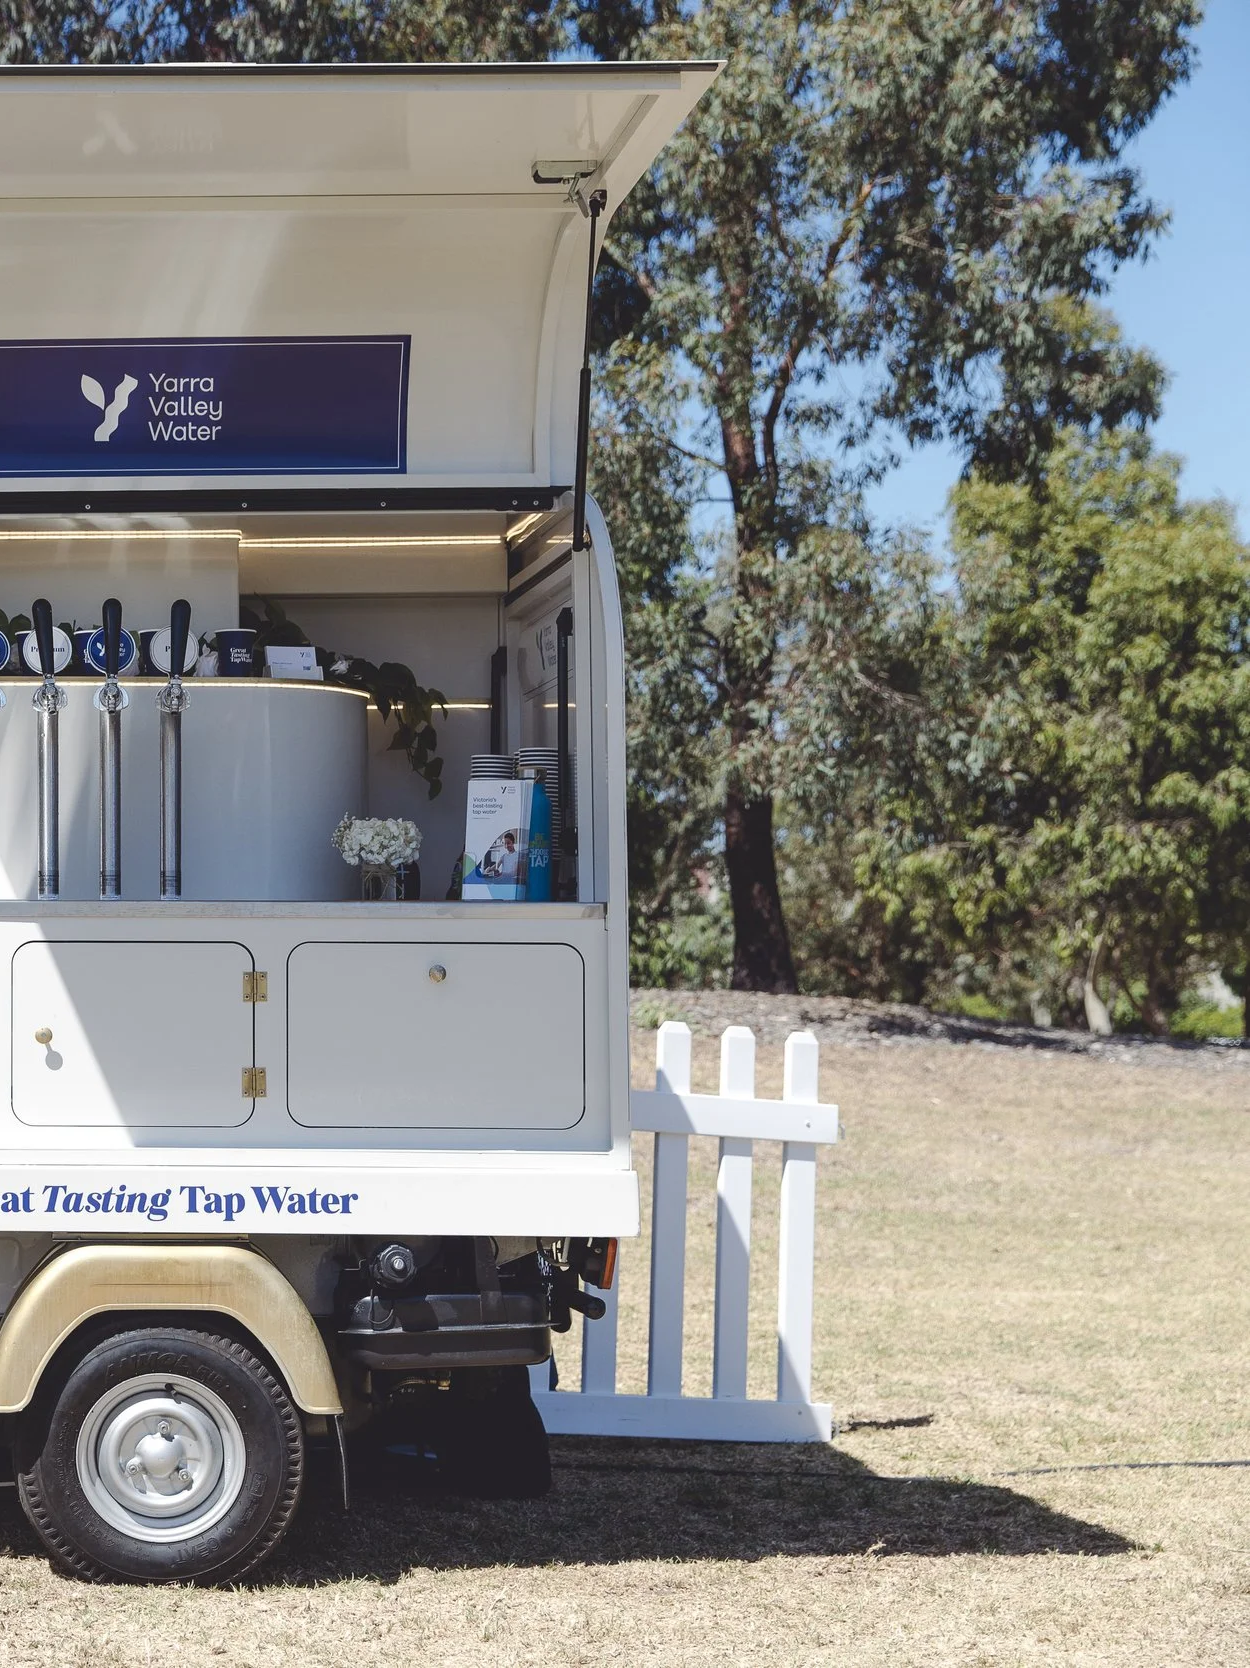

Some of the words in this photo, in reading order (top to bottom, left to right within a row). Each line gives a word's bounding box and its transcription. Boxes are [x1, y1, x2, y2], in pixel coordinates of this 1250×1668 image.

[148, 373, 214, 393] Yarra
[148, 396, 223, 421] Valley
[148, 421, 222, 442] Water
[529, 853, 550, 868] TAP
[42, 1184, 171, 1222] Tasting
[179, 1185, 246, 1222] Tap
[250, 1185, 359, 1215] Water
[176, 1537, 220, 1564] CEAT
